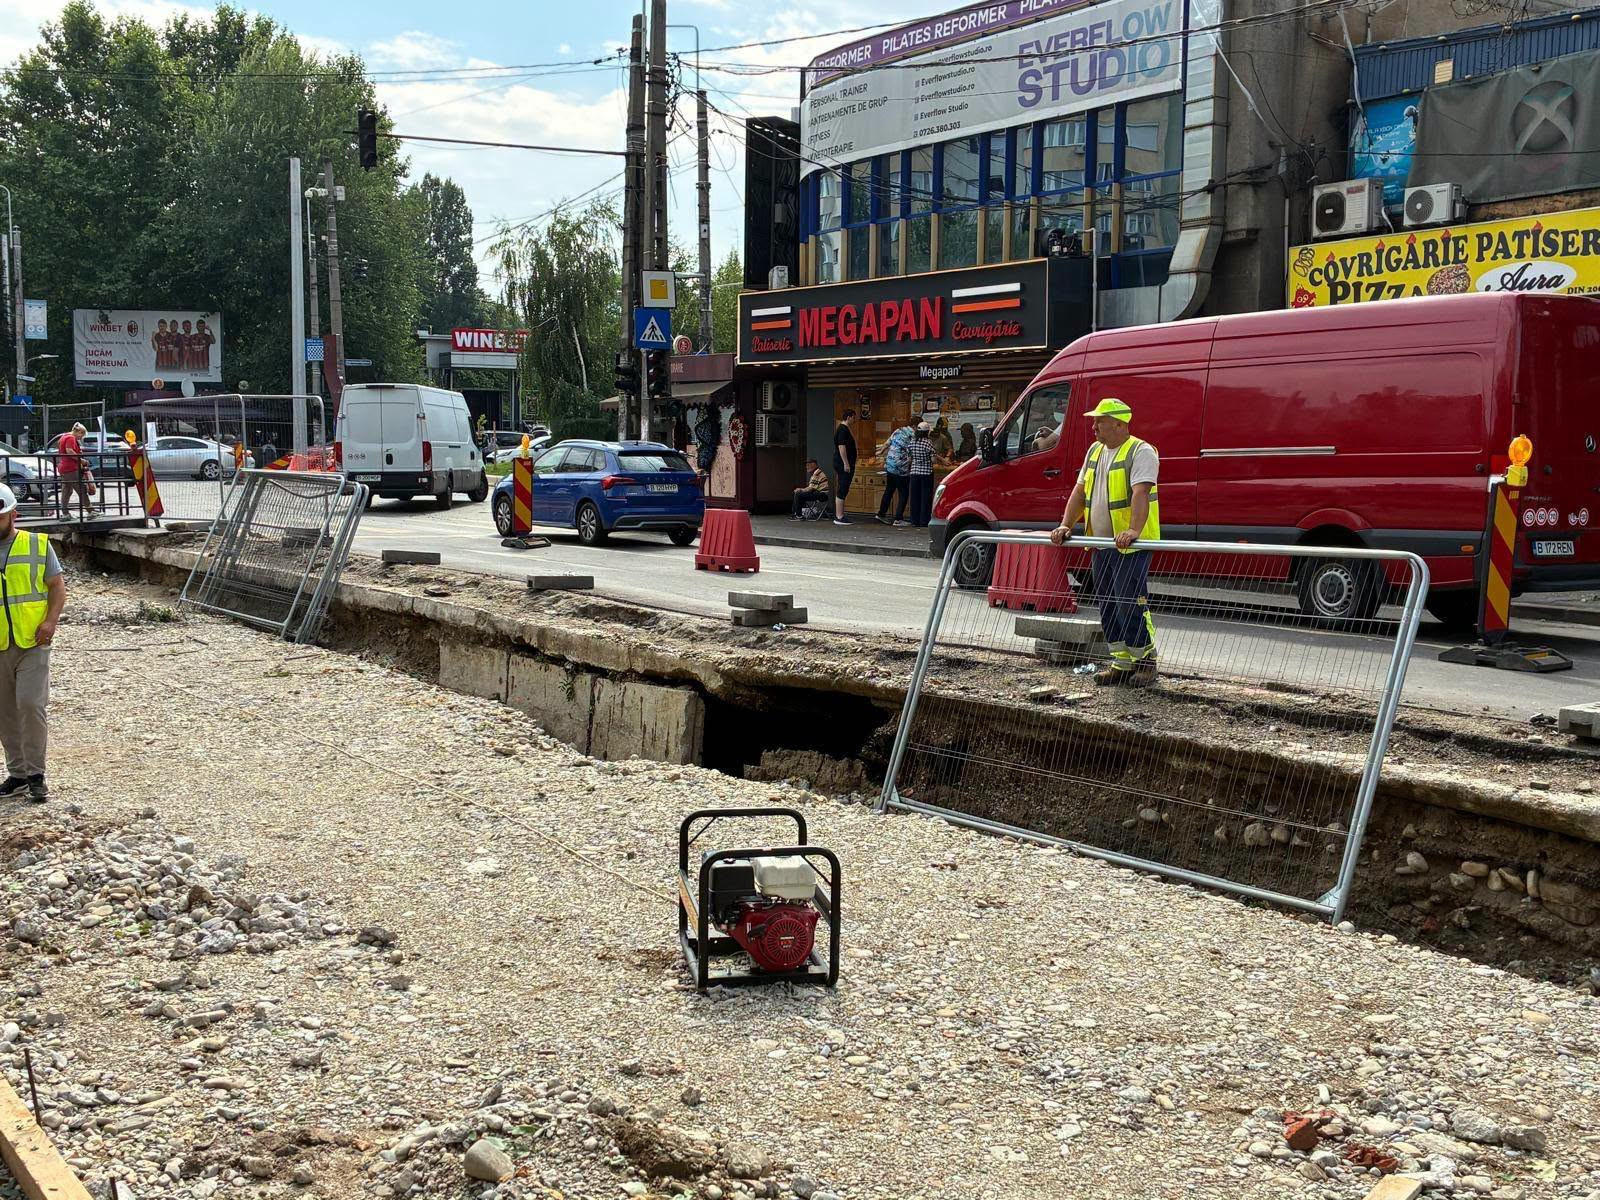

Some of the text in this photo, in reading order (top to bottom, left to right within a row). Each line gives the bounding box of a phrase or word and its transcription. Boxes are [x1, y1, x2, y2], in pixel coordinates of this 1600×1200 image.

[882, 4, 1007, 54] PILATES REFORMER
[1018, 2, 1172, 69] EVERFLOW
[1018, 40, 1171, 108] STUDIO
[810, 83, 868, 109] PERSONAL TRAINER
[858, 101, 867, 112] DE
[869, 96, 888, 109] GRUP
[920, 101, 969, 120] Everflow Studio
[919, 121, 961, 137] 0726.380.303
[1489, 262, 1566, 292] Aura
[1567, 286, 1585, 295] DIN
[89, 323, 123, 333] WINBET
[798, 295, 943, 348] MEGAPAN
[1537, 542, 1543, 554] B
[1557, 542, 1573, 554] REN
